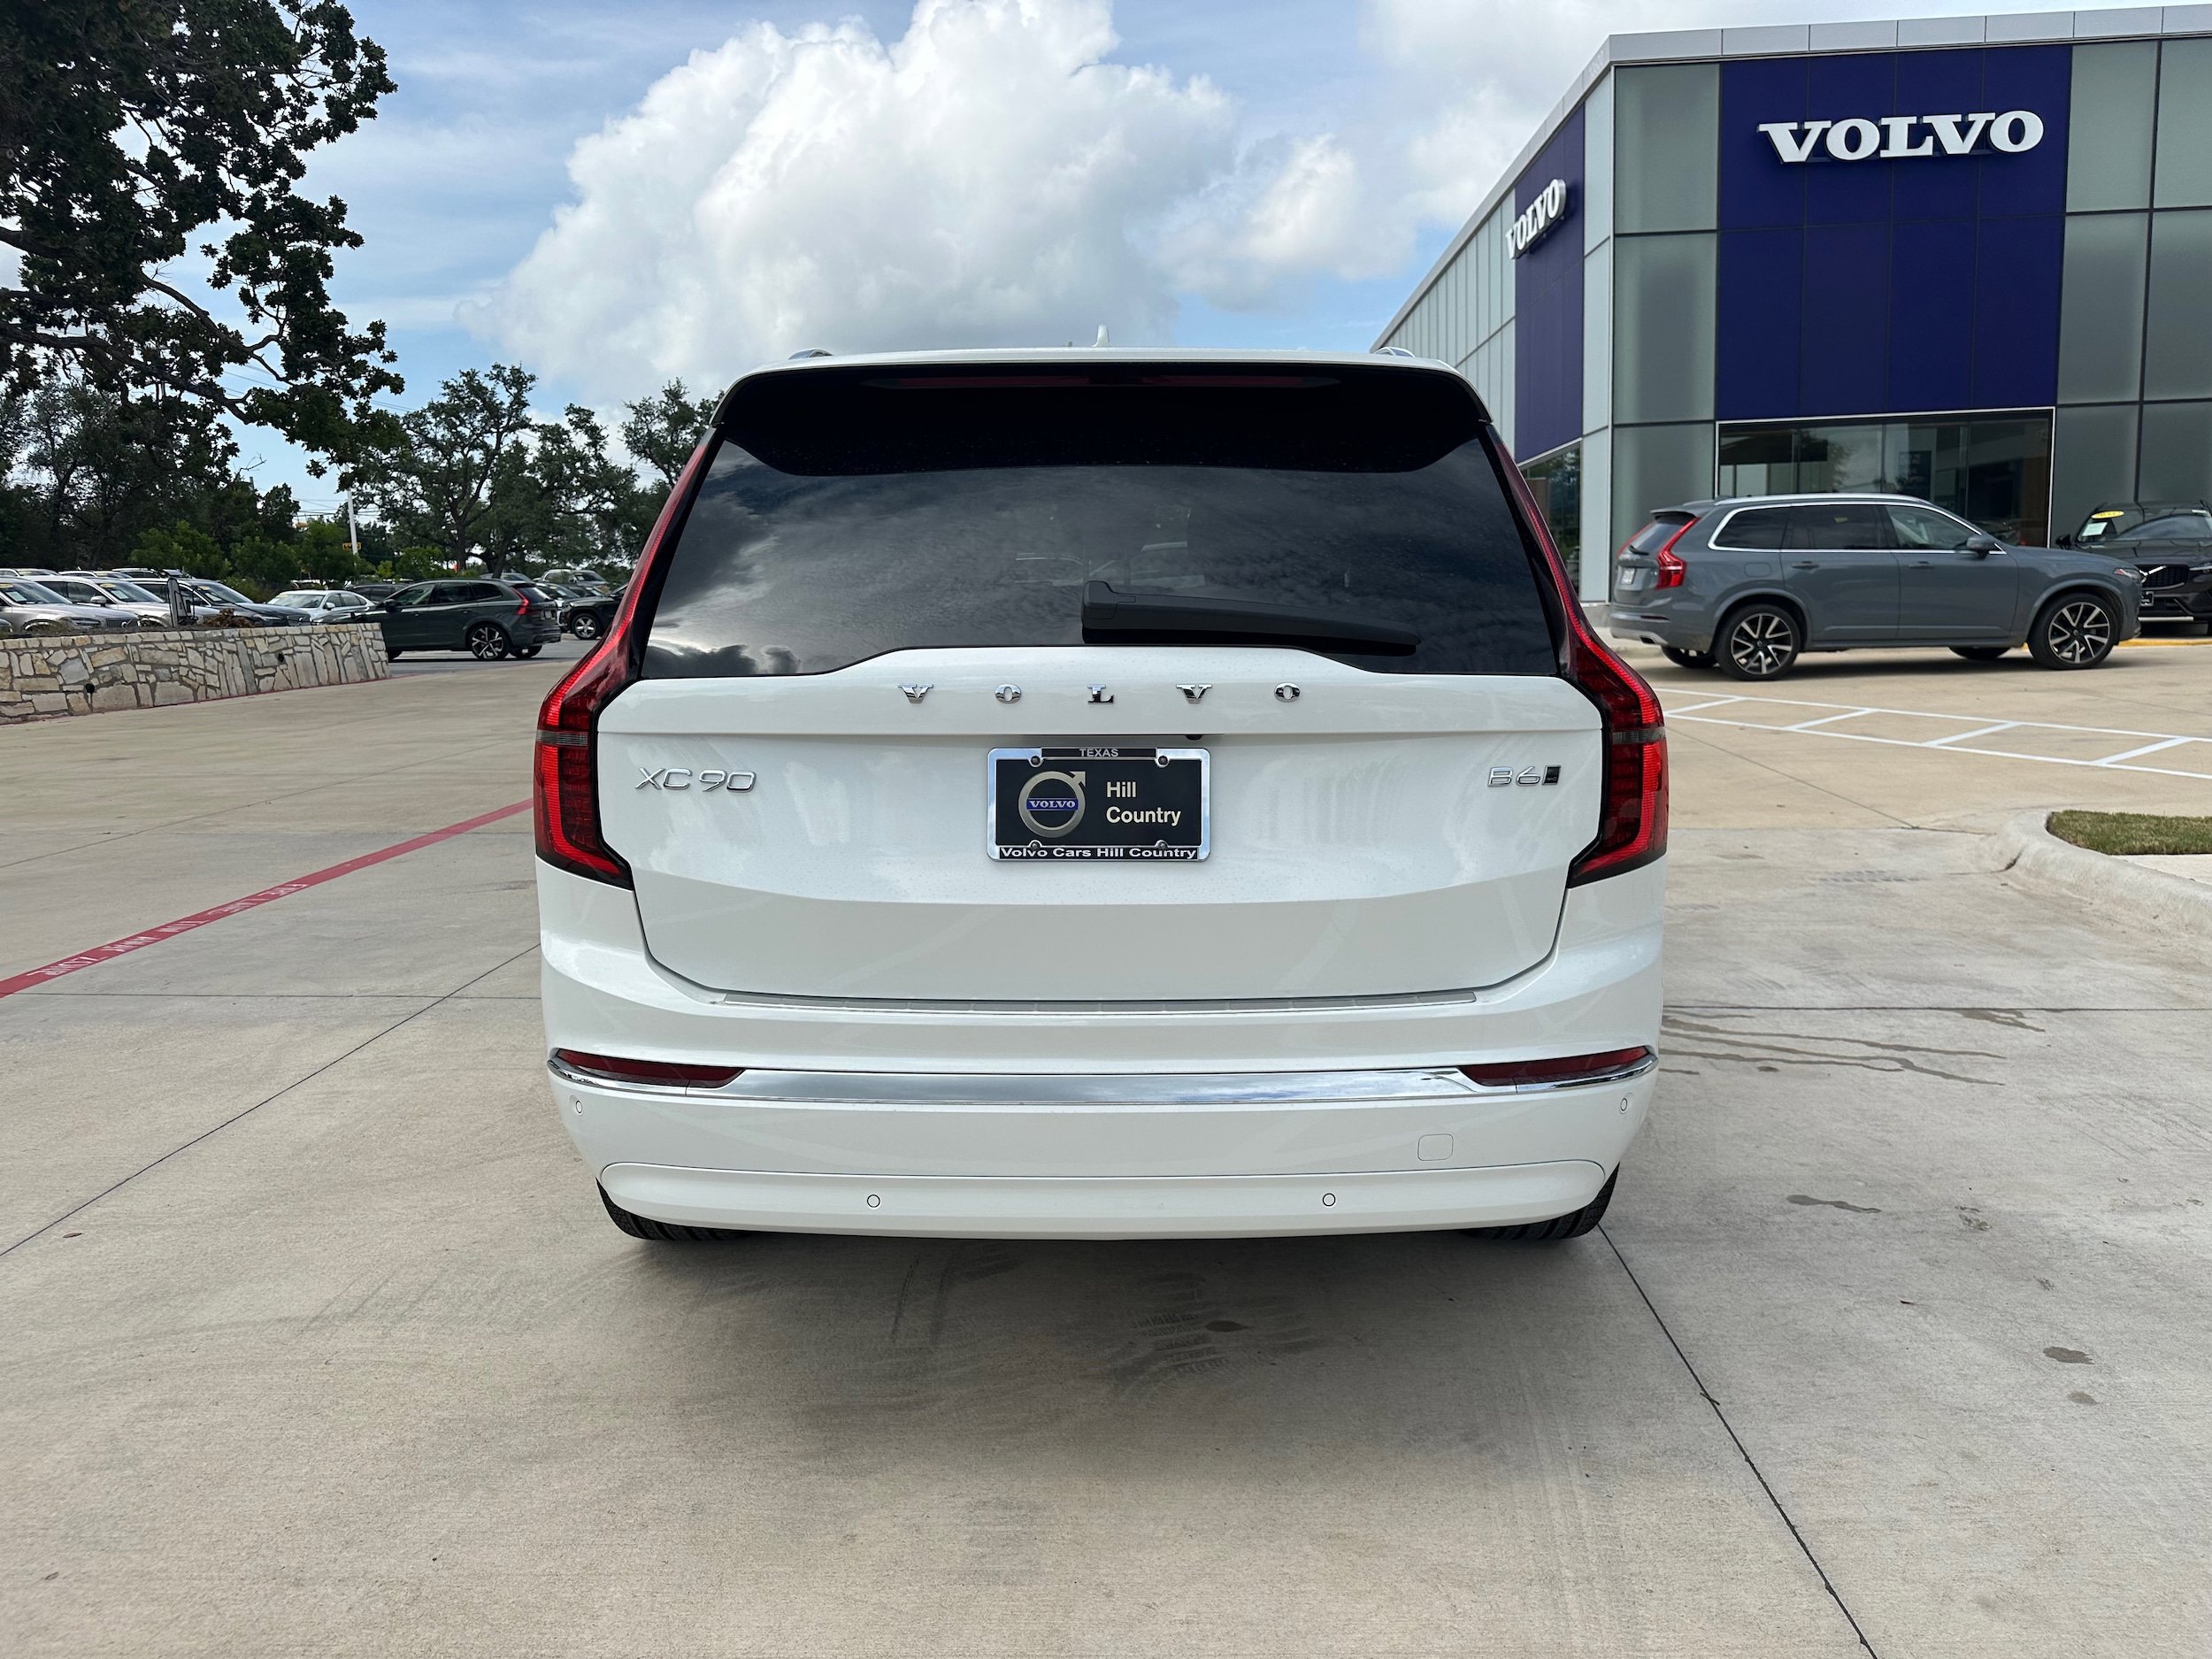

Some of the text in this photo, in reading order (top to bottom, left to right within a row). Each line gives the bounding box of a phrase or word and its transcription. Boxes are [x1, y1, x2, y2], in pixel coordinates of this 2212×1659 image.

[1758, 110, 2044, 163] VOLVO
[1505, 179, 1565, 259] VOLVO
[897, 681, 1302, 704] VOLVO
[1079, 749, 1119, 757] TEXAS
[1487, 765, 1541, 787] B6
[1106, 781, 1137, 798] Hill
[1029, 800, 1076, 809] VOLVO
[1106, 806, 1181, 826] Country
[1001, 848, 1197, 860] Volvo Cars Hill Country
